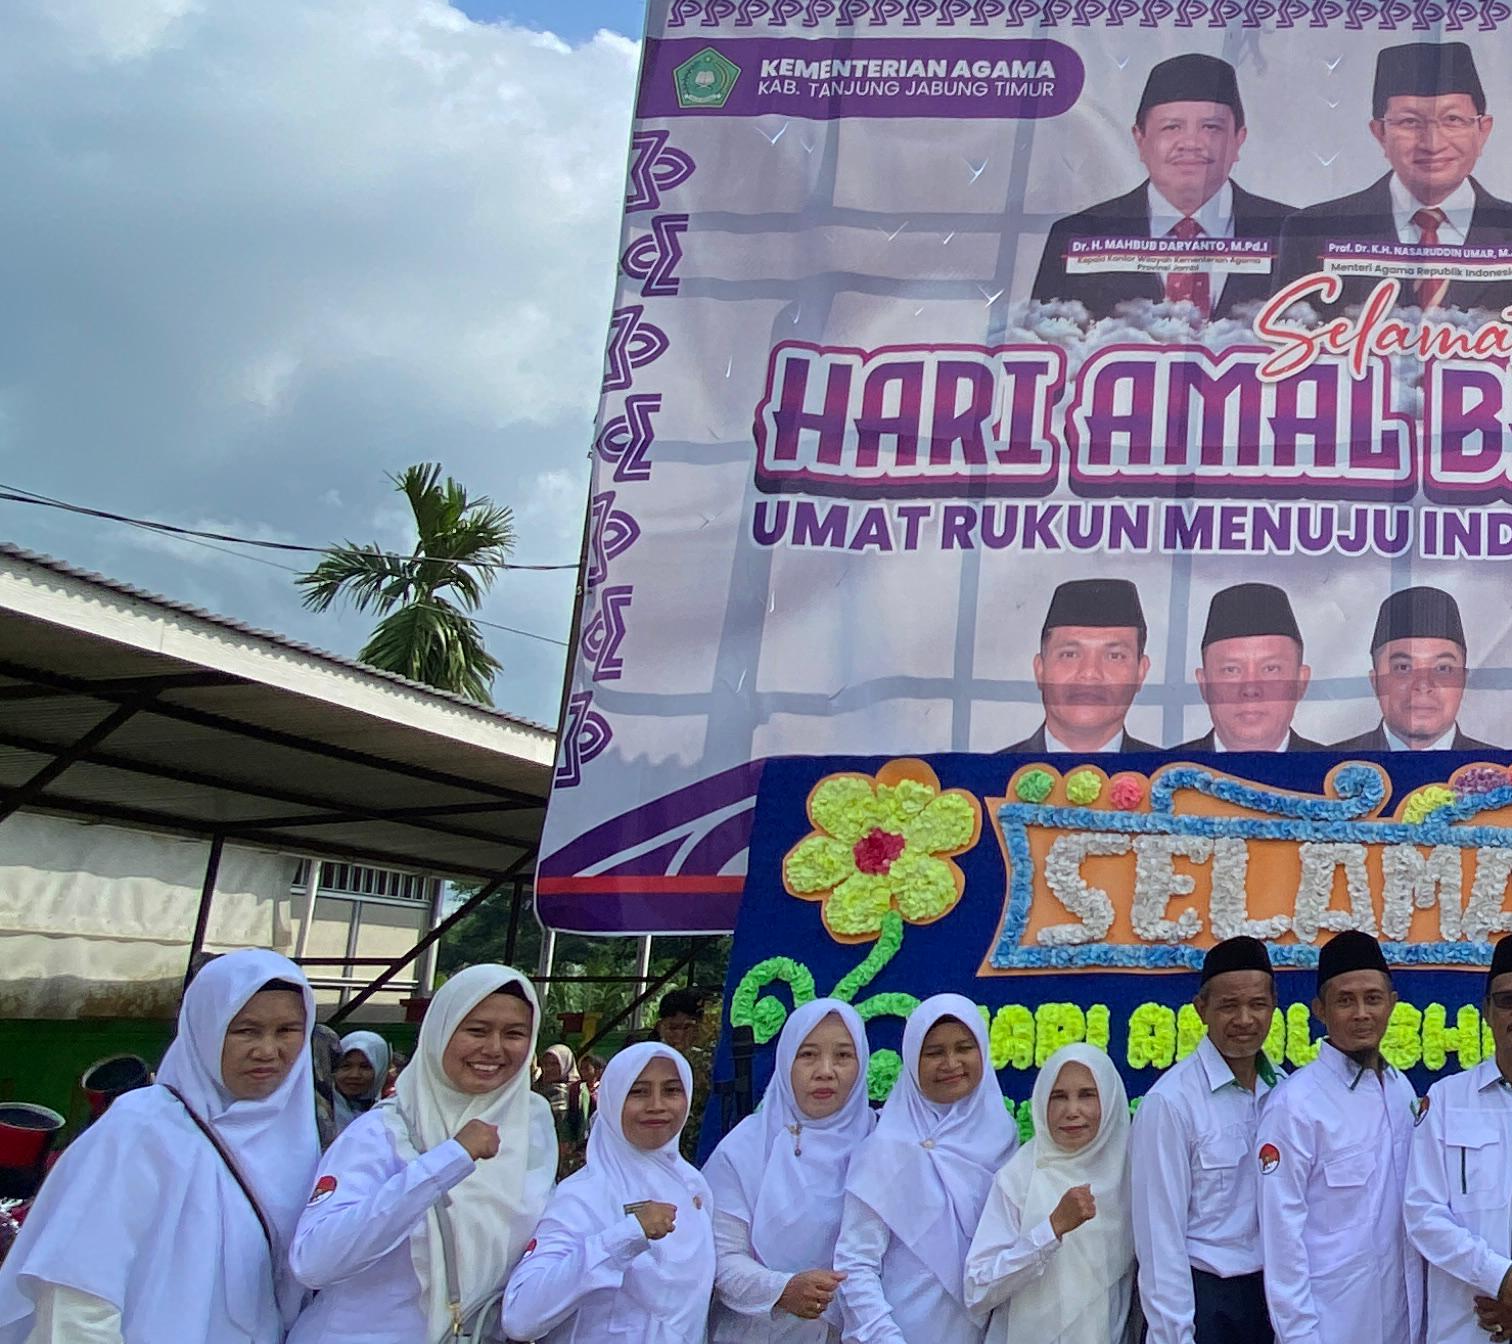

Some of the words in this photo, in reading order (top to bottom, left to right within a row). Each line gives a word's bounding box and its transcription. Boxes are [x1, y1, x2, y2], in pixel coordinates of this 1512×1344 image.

[760, 58, 948, 80] KEMENTERIAN
[951, 59, 1056, 80] AGAMA
[758, 80, 800, 96] KAB.
[809, 81, 900, 99] TANJUNG
[905, 81, 989, 97] JABUNG
[994, 81, 1055, 97] TIMUR
[1072, 241, 1090, 253] Dr.
[1091, 240, 1102, 251] H.
[1104, 239, 1157, 252] MAHBUB
[1158, 240, 1229, 253] DARYANTO,
[1328, 242, 1354, 253] Prof.
[1355, 243, 1370, 254] Dr.
[1371, 245, 1393, 255] K.H.
[1393, 246, 1462, 258] NASARUDDIN
[1330, 262, 1373, 273] Menteri
[1374, 264, 1415, 275] Agama
[1416, 266, 1463, 276] Republik
[763, 348, 1060, 478] HARI
[1078, 350, 1405, 480] AMAL
[751, 500, 931, 552] UMAT
[941, 503, 1152, 553] RUKUN
[1163, 503, 1409, 554] MENUJU
[977, 1002, 1110, 1070] ARI
